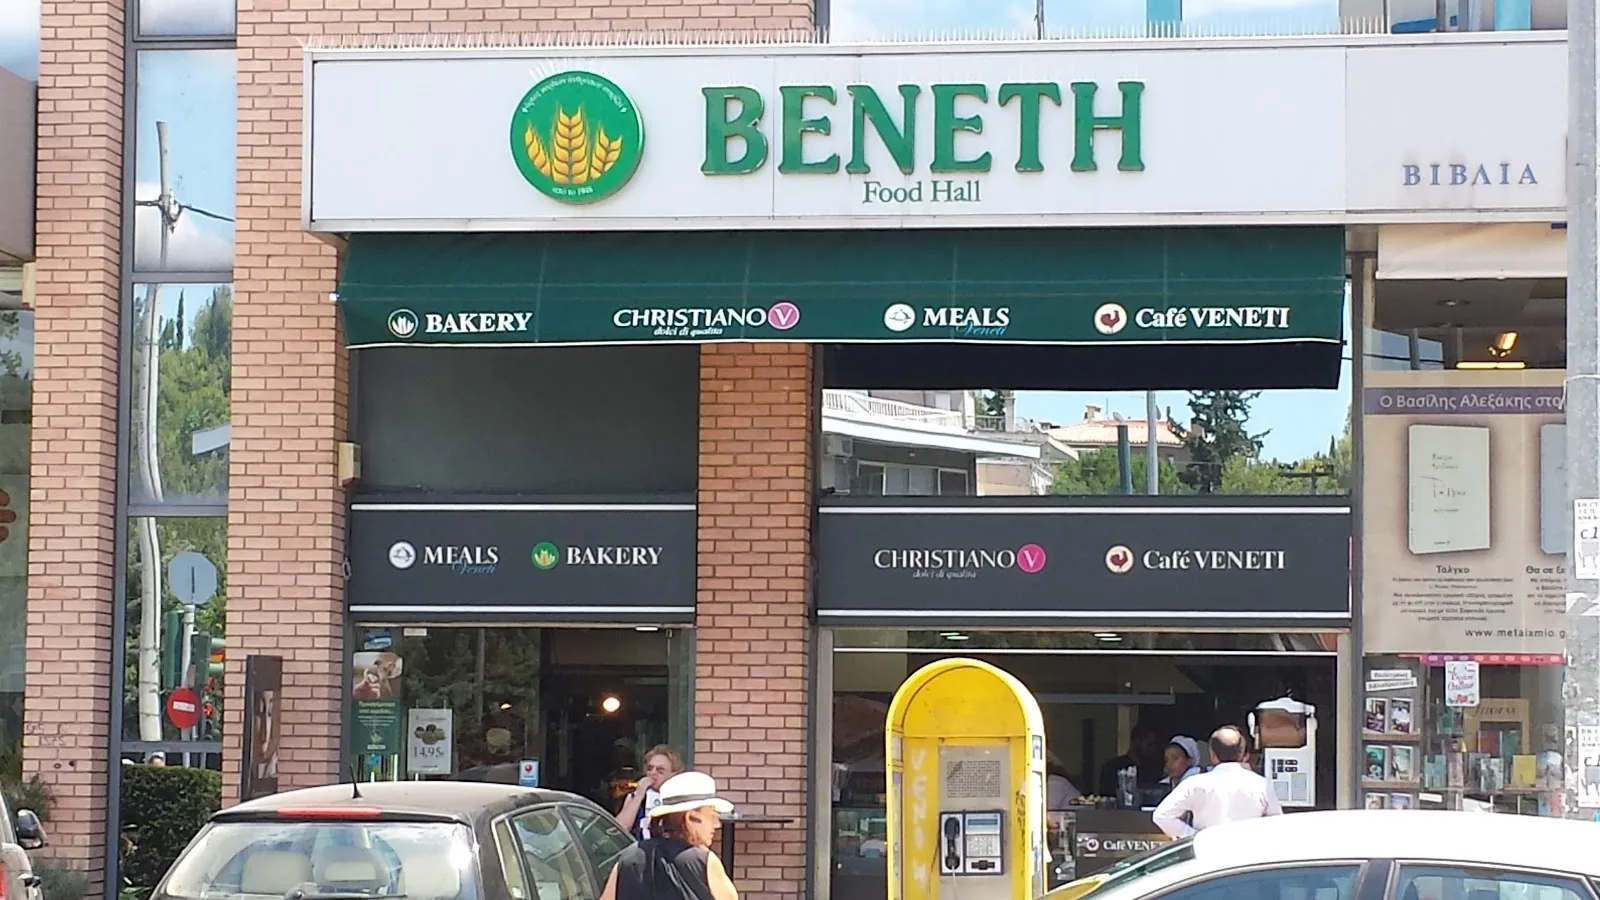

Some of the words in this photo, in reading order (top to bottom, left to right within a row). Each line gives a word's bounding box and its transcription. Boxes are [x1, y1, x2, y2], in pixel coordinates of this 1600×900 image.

[1402, 163, 1538, 186] ΒΙΒΛΙΑ
[863, 181, 922, 203] Food
[930, 180, 980, 203] Hall
[425, 312, 533, 333] BAKERY
[613, 307, 767, 328] CHRISTIANO
[922, 307, 1010, 327] MEALS
[1135, 307, 1187, 327] Café
[1189, 306, 1290, 327] VENETI
[653, 326, 678, 336] dolci
[678, 326, 690, 336] di
[1380, 395, 1393, 408] Ο
[1396, 394, 1457, 410] Βασίλης
[1459, 394, 1532, 410] Αλεξάκης
[423, 546, 499, 565] MEALS
[567, 546, 663, 565] BAKERY
[874, 549, 1015, 569] CHRISTIANO
[1143, 549, 1190, 569] Café
[1193, 550, 1285, 569] VENETI
[1525, 565, 1540, 574] Θα
